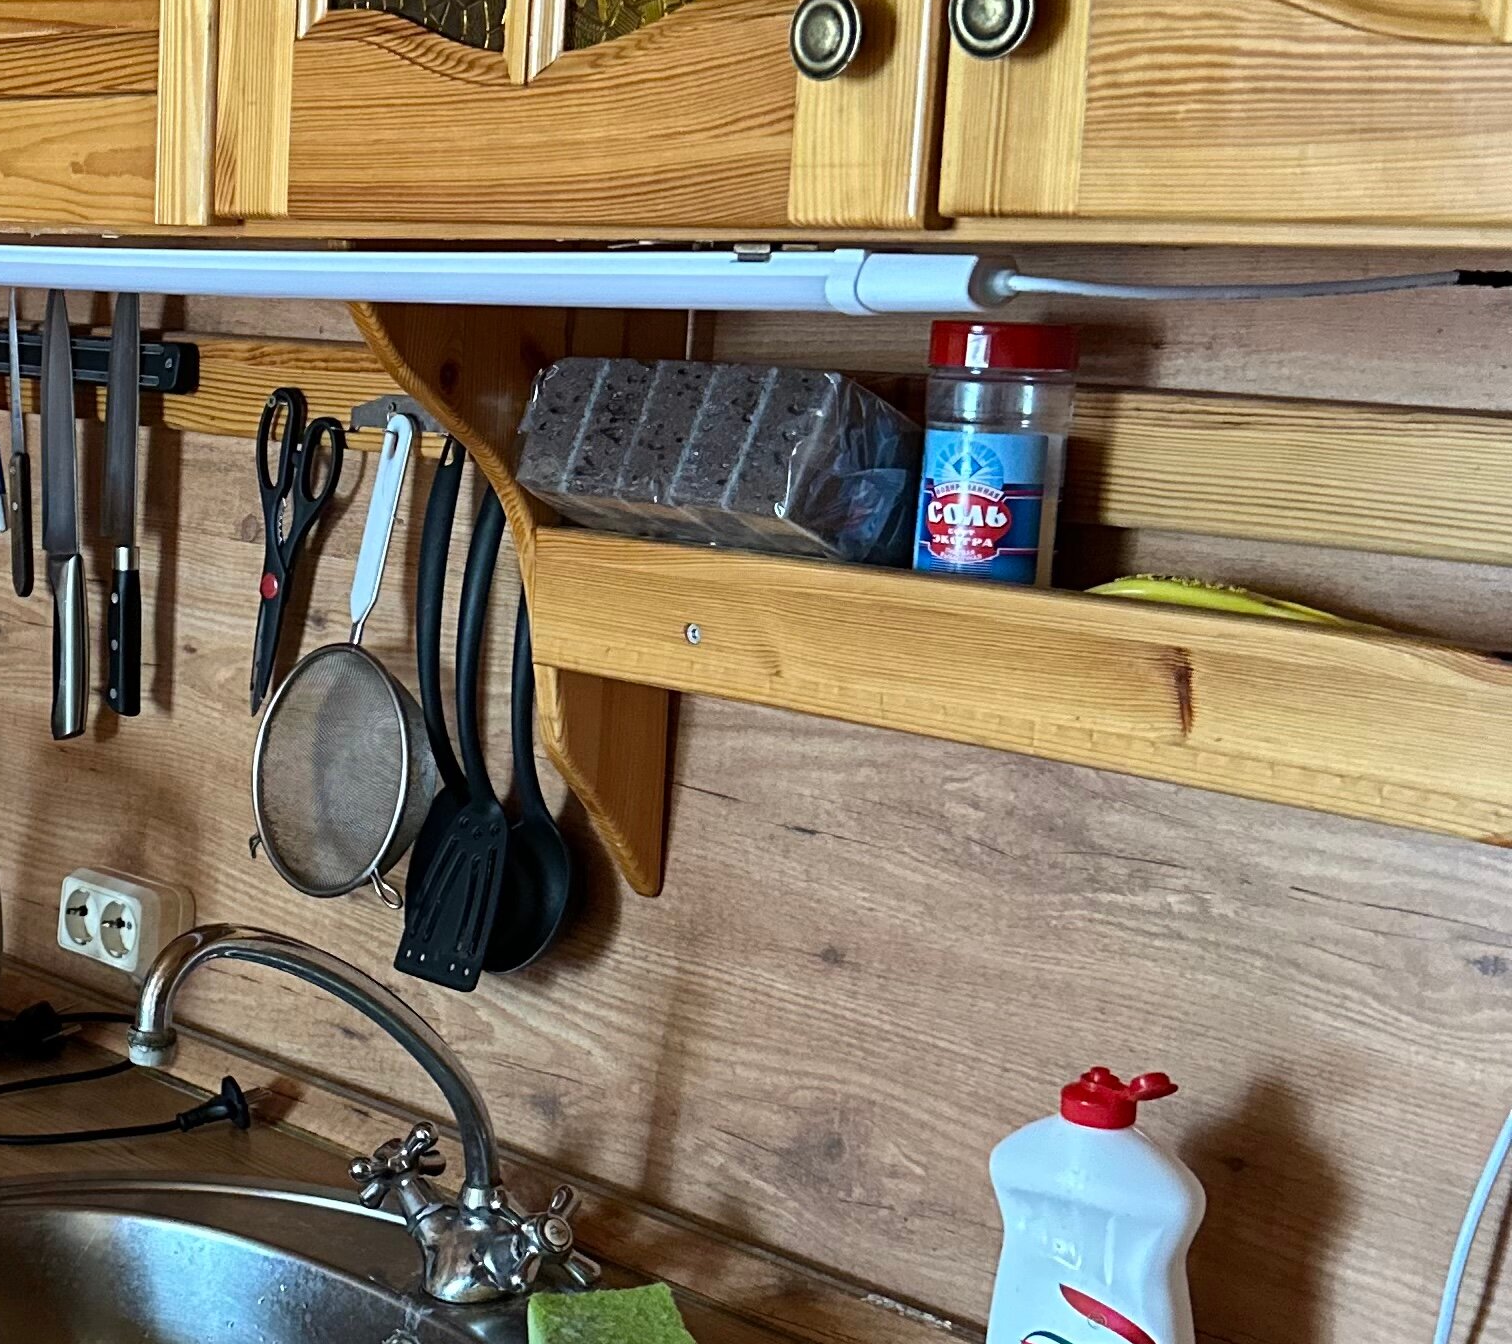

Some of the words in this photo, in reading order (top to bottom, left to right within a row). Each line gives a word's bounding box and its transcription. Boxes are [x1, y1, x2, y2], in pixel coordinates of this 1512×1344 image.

[936, 484, 1000, 499] ЙОДИРВАННАЯ
[928, 501, 1008, 528] СОЛЬ
[932, 534, 993, 547] ЭКСТРА
